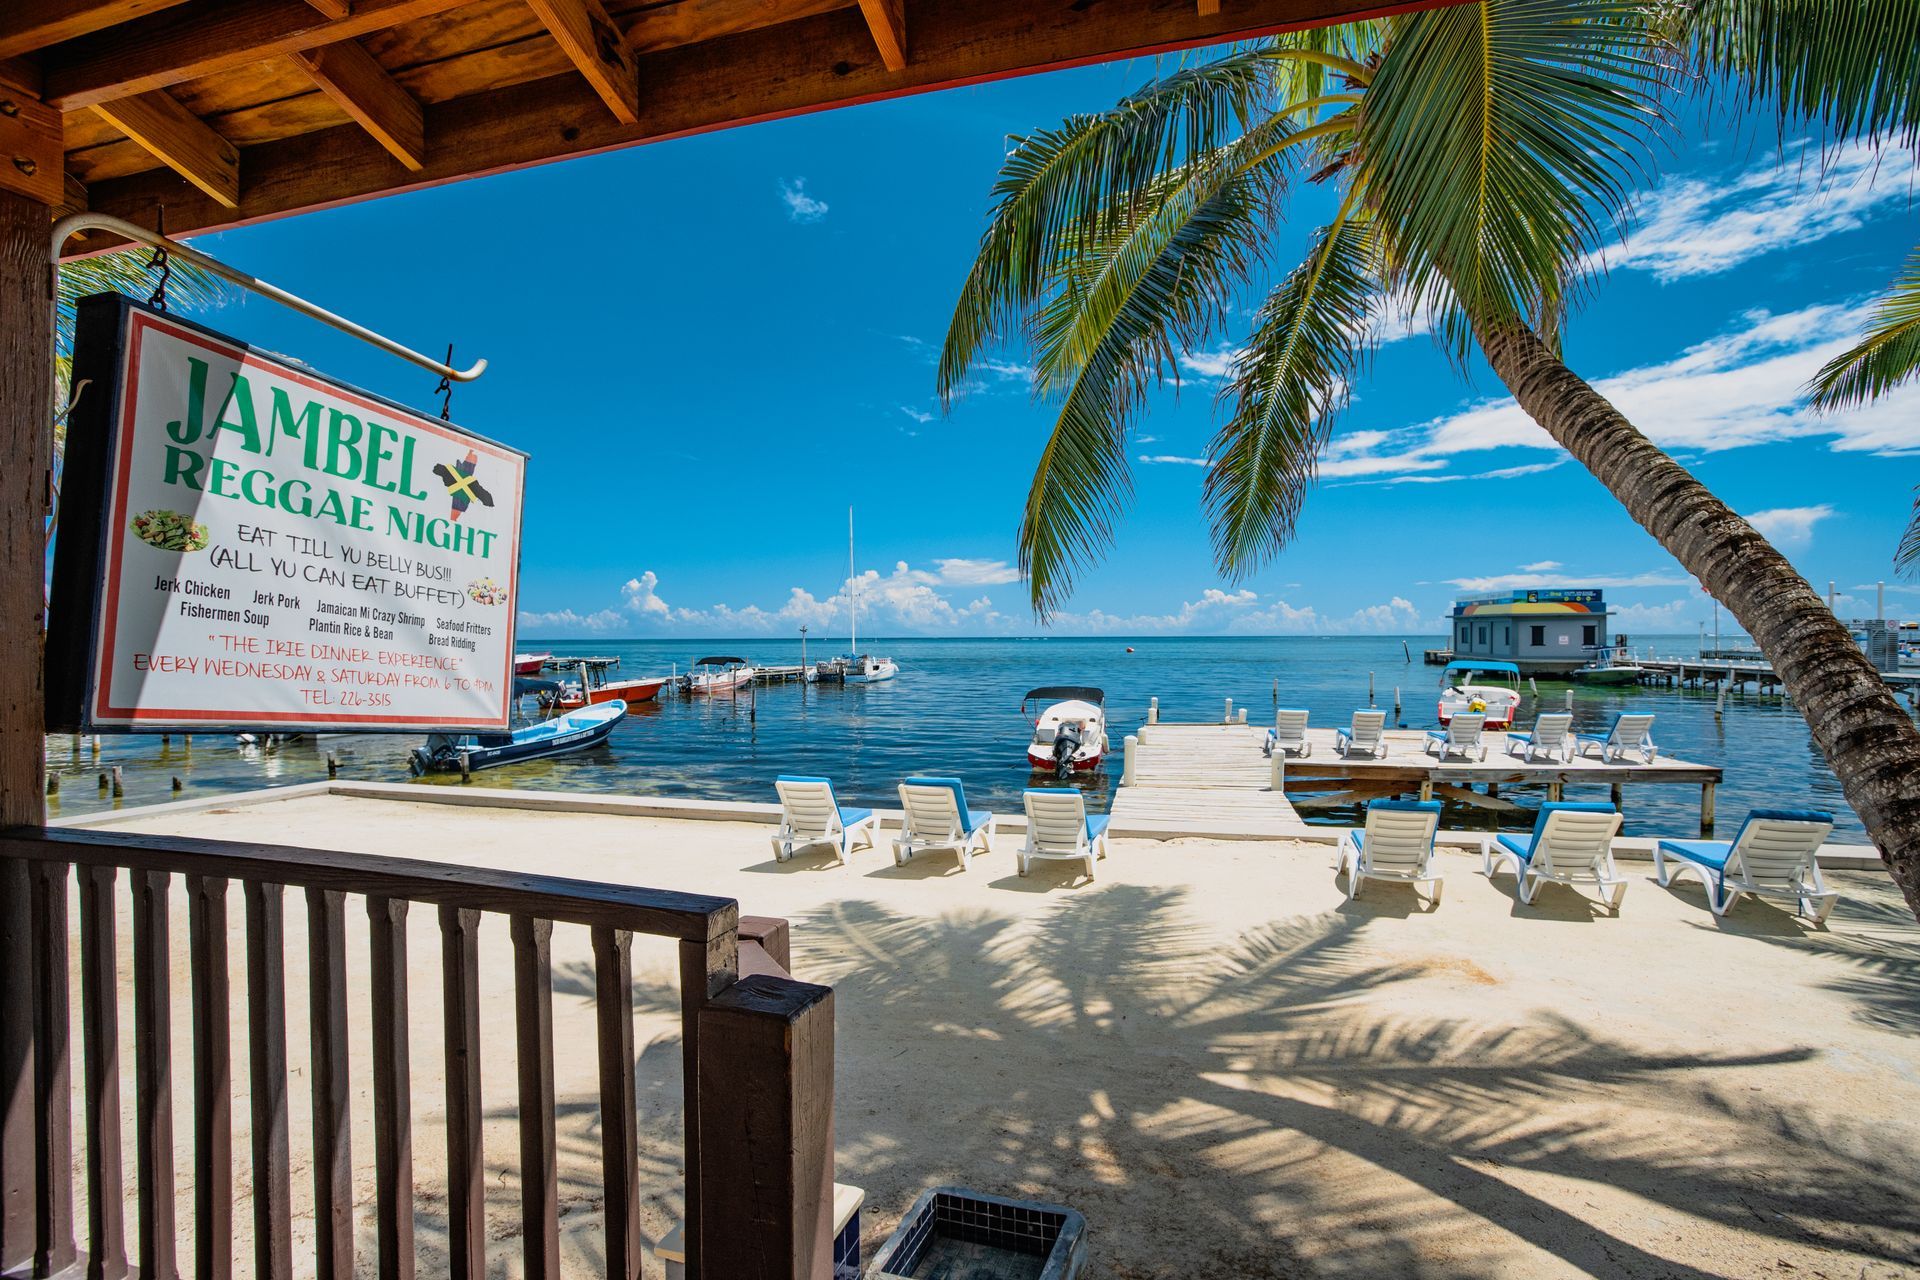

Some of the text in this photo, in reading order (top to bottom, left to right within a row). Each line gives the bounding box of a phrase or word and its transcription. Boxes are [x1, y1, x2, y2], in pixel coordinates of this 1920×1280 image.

[166, 356, 428, 502] JAMBEL
[163, 445, 498, 559] REGGAE NIGHT
[237, 523, 452, 582] EAT TILL YU BELLY BUS!!!
[154, 575, 231, 600] Jerk Chicken
[209, 544, 465, 609] (ALL YU CAN EAT BUFFET)
[252, 590, 301, 610] Jerk Pork
[316, 599, 426, 629] Jamaican Mi Crazy Shrimp
[180, 601, 270, 629] Fishermen Soup
[309, 618, 394, 641] Plantin Rice & Bean
[436, 617, 492, 636] Seafood Fritters
[219, 635, 260, 653] THE
[265, 639, 306, 657] IRIE
[311, 644, 374, 663] DINNER
[378, 650, 464, 671] EXPERIENCE"
[428, 633, 476, 652] Bread Ridding
[133, 653, 199, 675] EVERY
[204, 657, 313, 682] WEDNESDAY
[316, 670, 326, 683] &
[330, 668, 400, 687] SATURDAY
[404, 674, 440, 690] FROM
[443, 677, 452, 690] 6
[453, 677, 471, 691] TO
[300, 689, 392, 707] TEL: 226-3515
